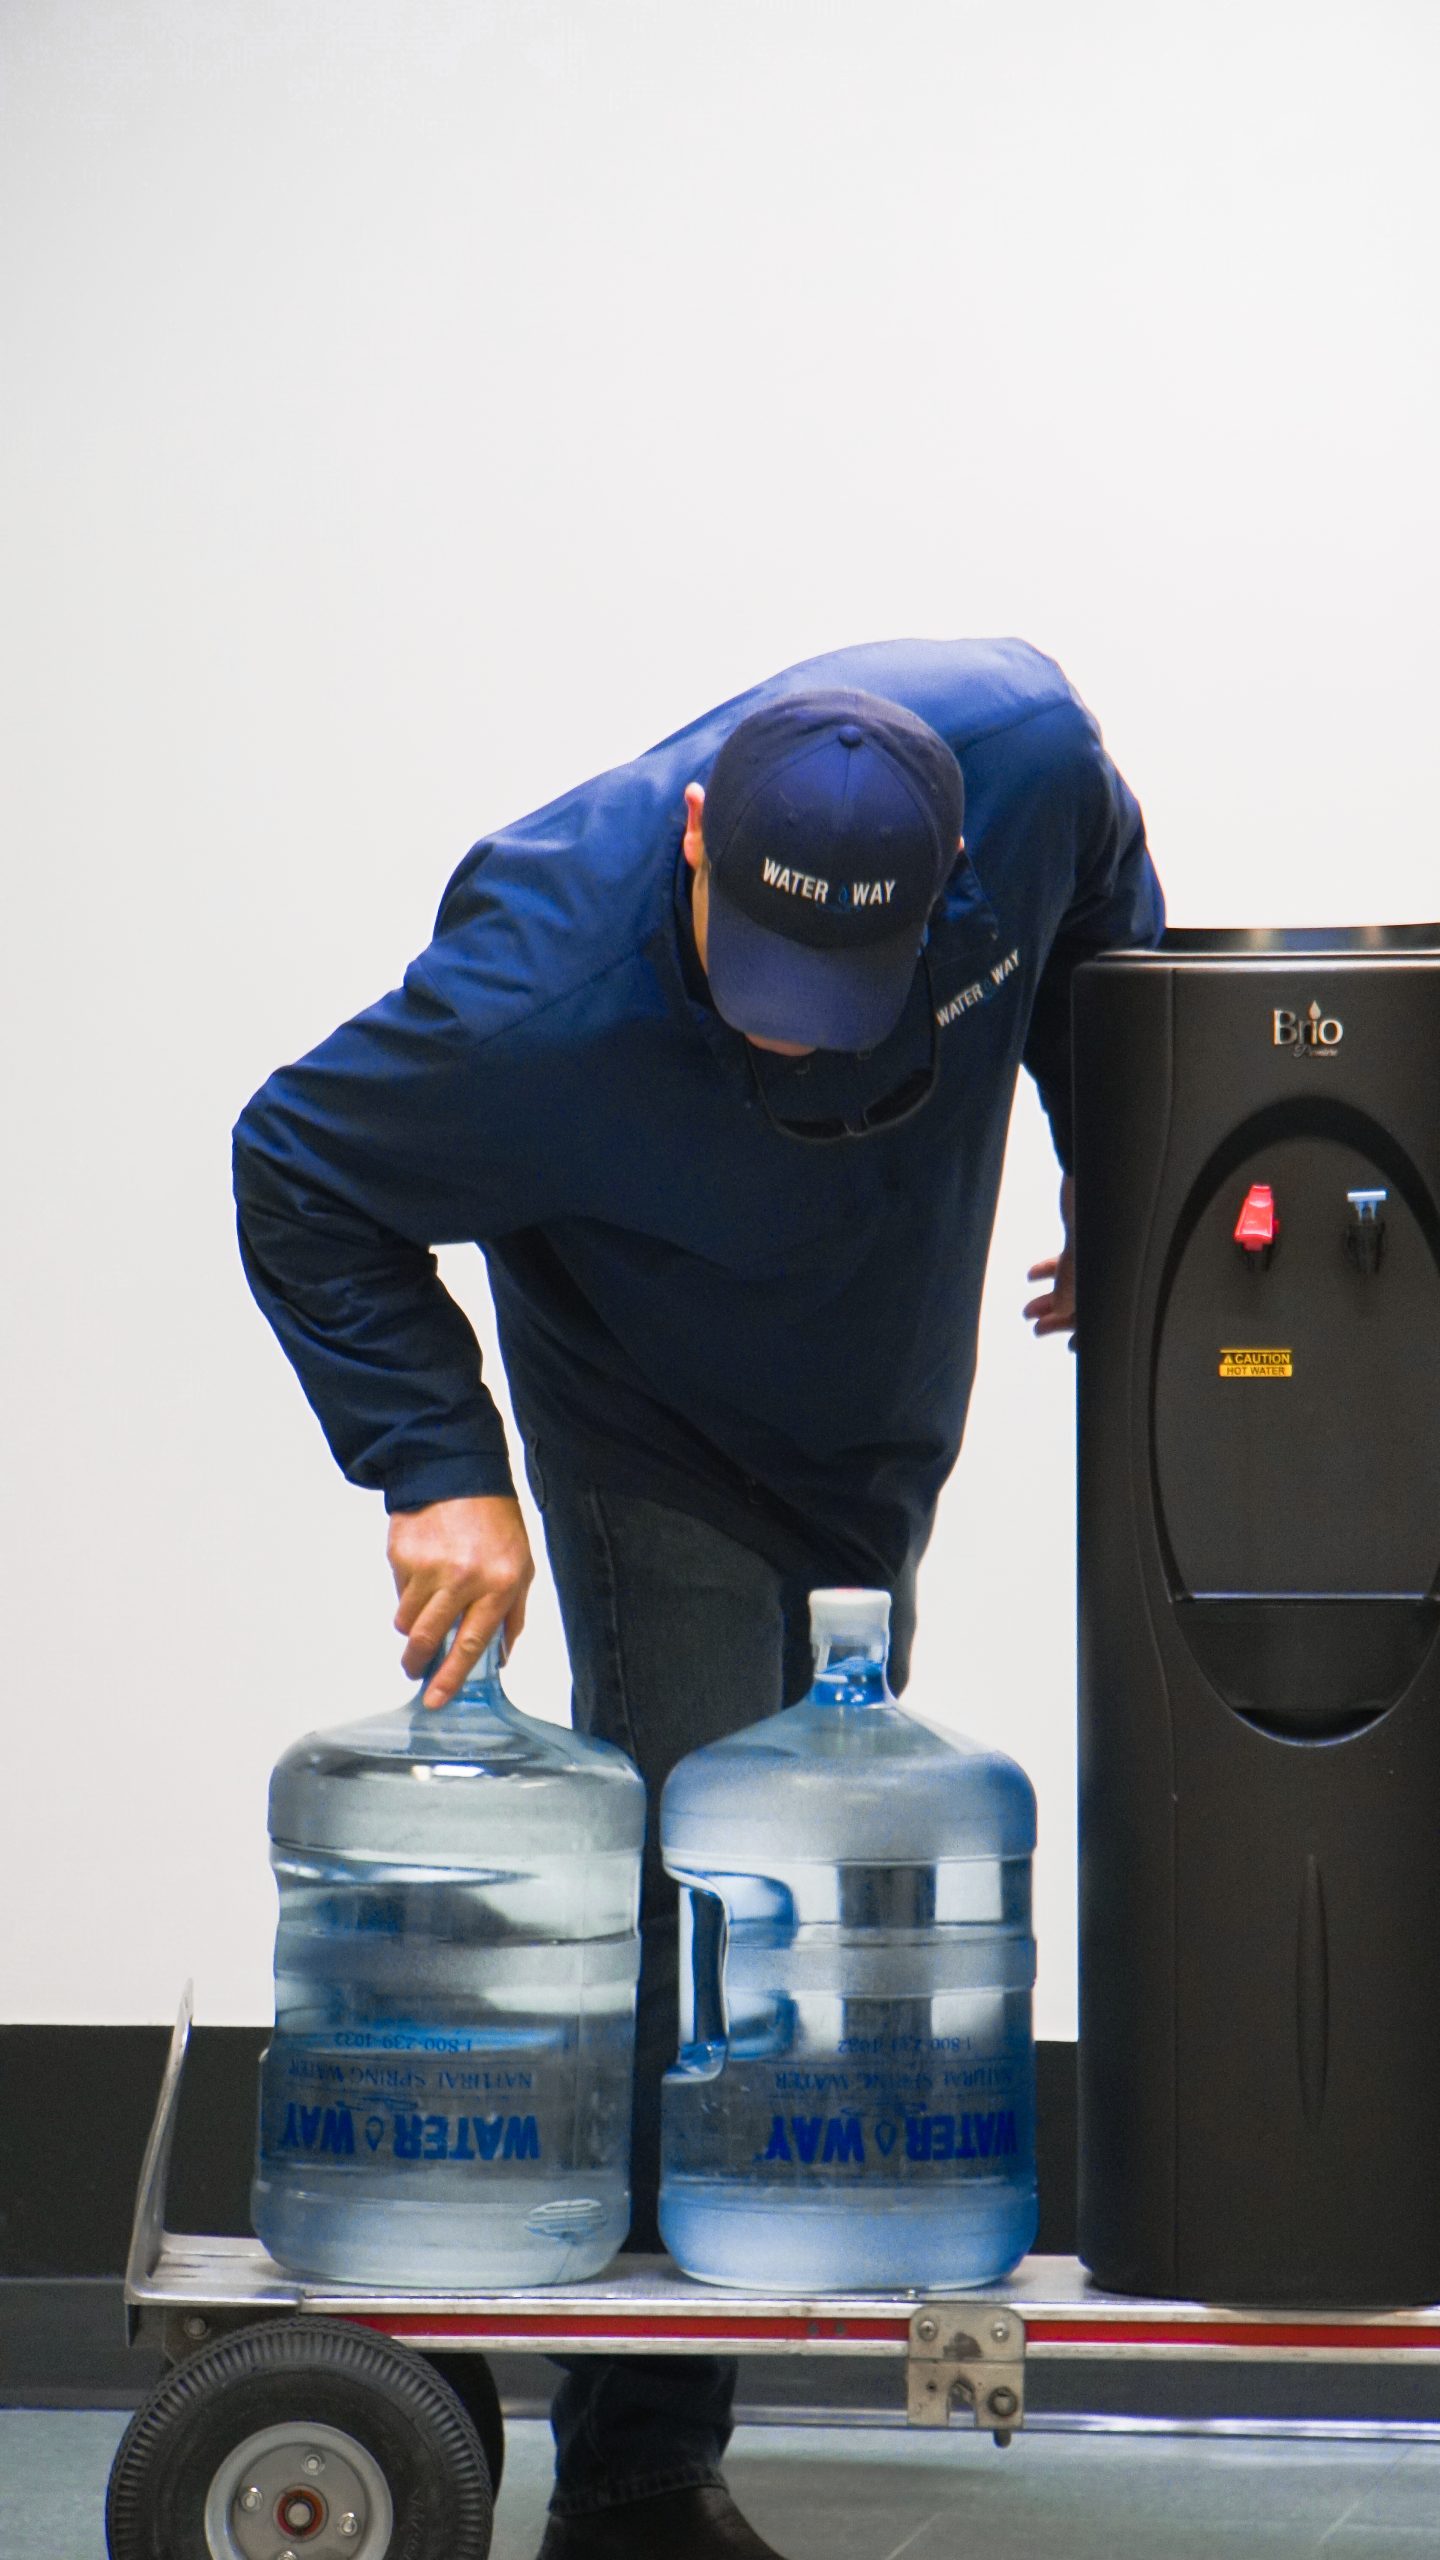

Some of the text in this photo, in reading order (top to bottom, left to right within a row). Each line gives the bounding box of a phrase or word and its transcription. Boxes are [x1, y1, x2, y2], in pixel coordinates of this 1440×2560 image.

[762, 857, 896, 906] WATER WAY
[936, 948, 1019, 1027] WATER WAY
[1273, 1000, 1344, 1045] Brio
[1226, 1367, 1286, 1376] HOT WATER
[1235, 1353, 1290, 1364] CAUTION
[289, 2060, 531, 2089] NATURAL SPRING WATER
[774, 2072, 850, 2091] WATER
[280, 2102, 539, 2160] WATER WAY
[765, 2112, 1016, 2163] WATER WAY
